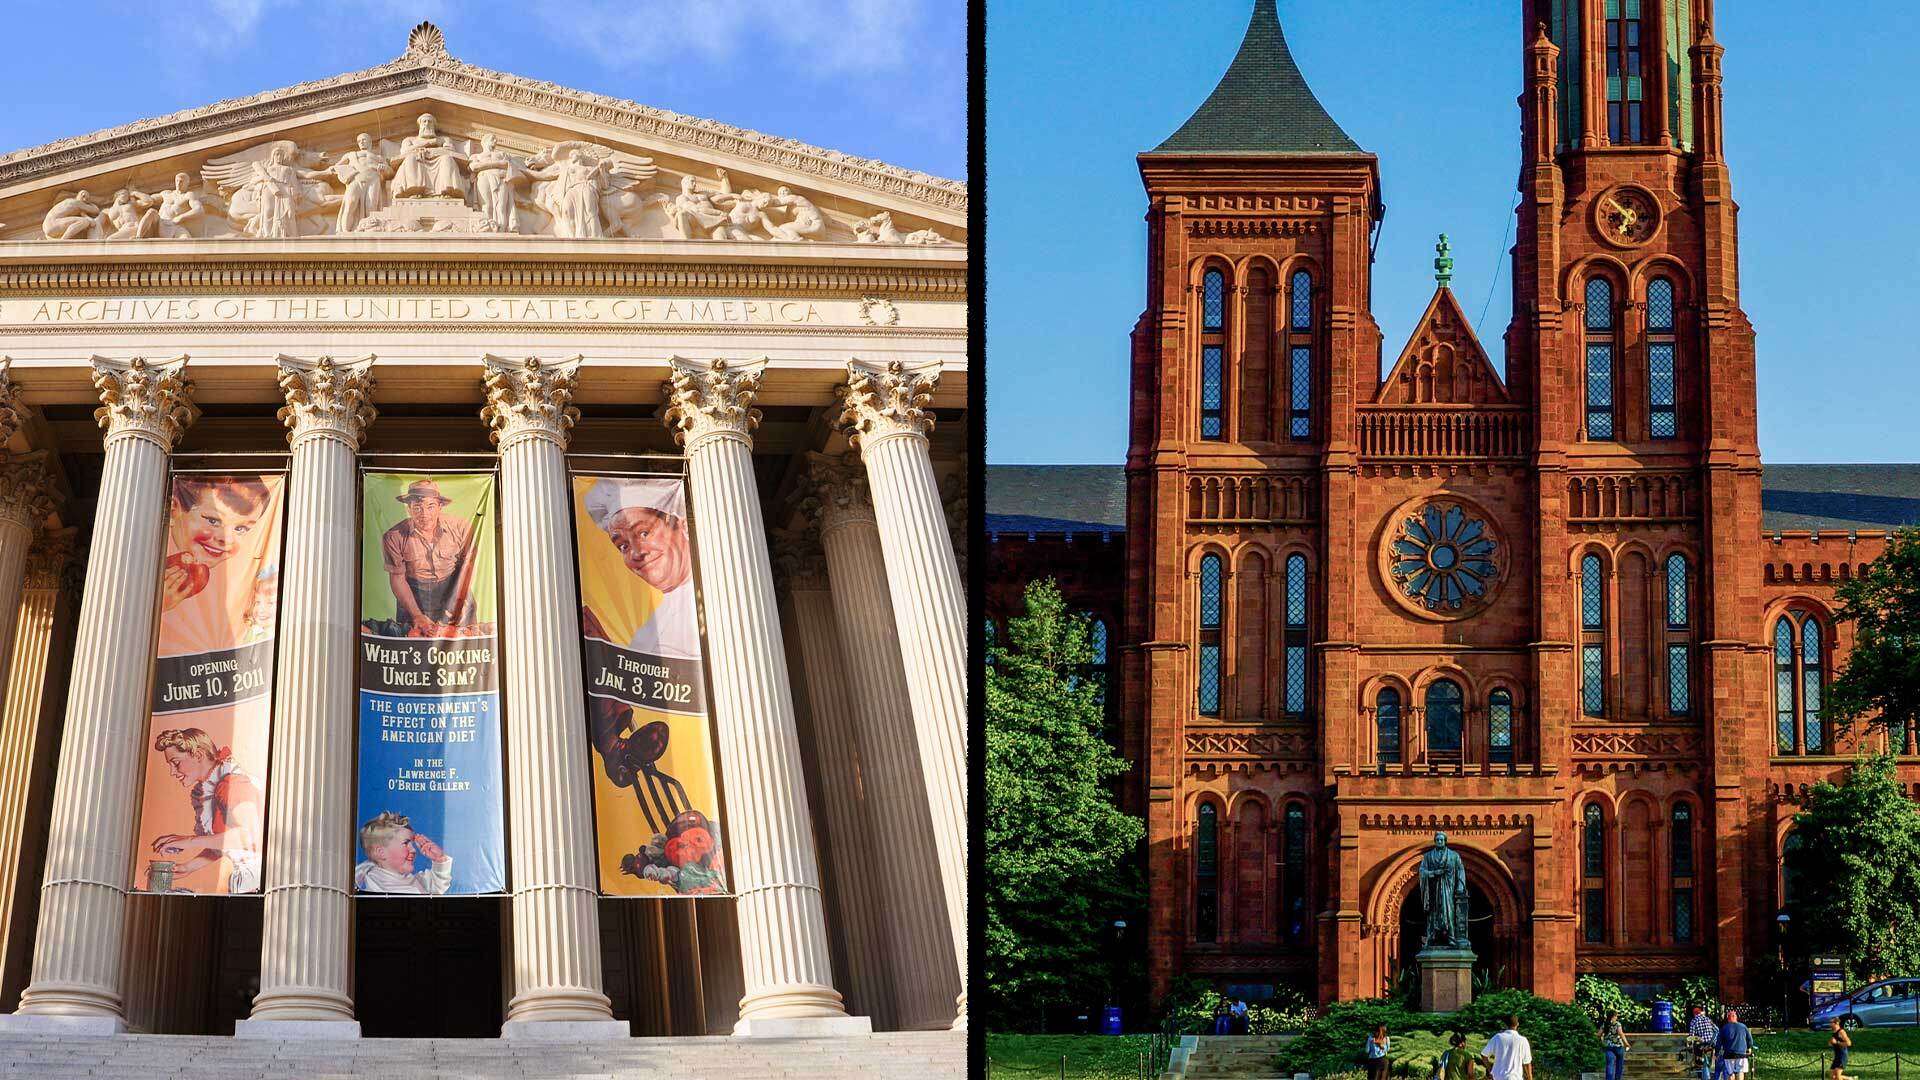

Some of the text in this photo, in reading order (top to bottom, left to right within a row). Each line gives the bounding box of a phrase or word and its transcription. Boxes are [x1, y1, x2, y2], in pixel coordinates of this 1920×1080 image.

[33, 299, 824, 322] ARCHIVES OF THE UNITED STATES OF AMERICA
[190, 659, 239, 677] OPENING
[617, 654, 670, 679] THROUGH
[163, 667, 265, 702] JUNE 10, 2011
[383, 666, 477, 687] UNCLE SAM?
[595, 667, 692, 703] JAN. 3, 2012
[370, 698, 488, 715] THE GOVERNMENT'S
[382, 715, 475, 728] EFFECT ON THE
[382, 730, 476, 743] AMERICAN DIET
[414, 759, 444, 768] IN THE
[449, 768, 459, 779] F.
